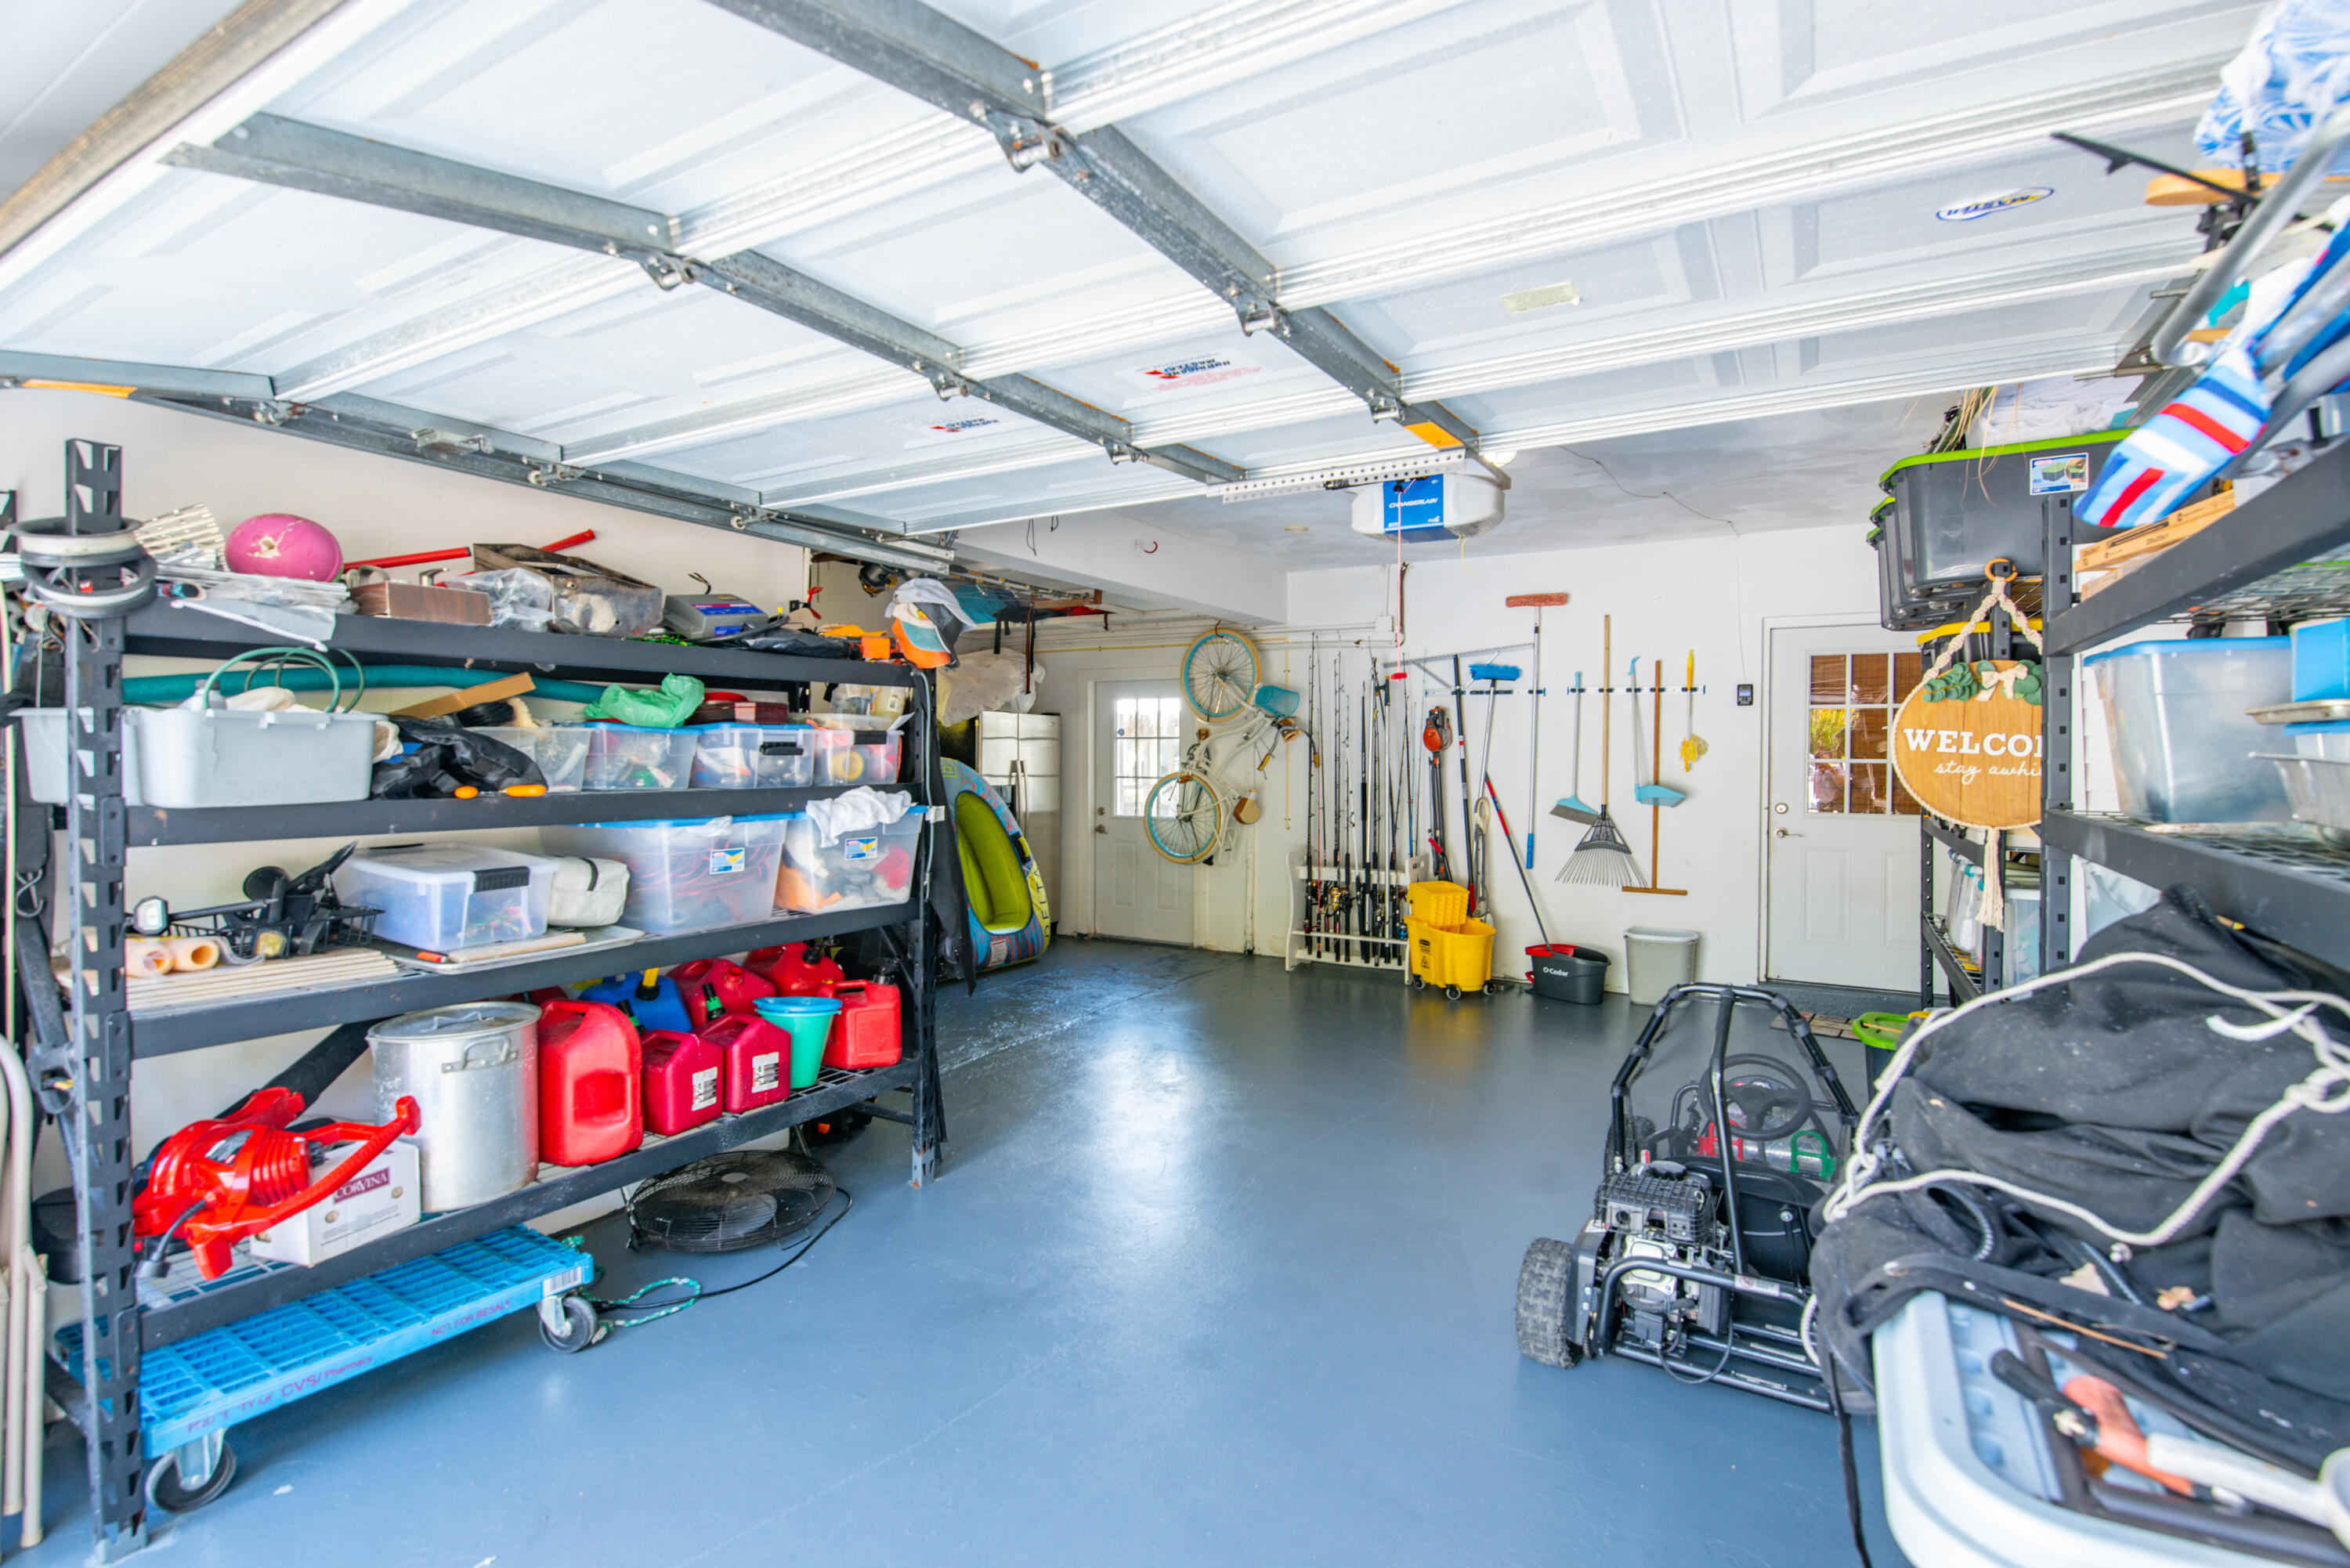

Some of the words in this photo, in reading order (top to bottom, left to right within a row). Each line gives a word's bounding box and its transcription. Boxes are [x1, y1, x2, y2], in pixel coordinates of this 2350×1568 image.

[1903, 728, 2042, 757] WELCO
[1934, 760, 1983, 785] stay
[1989, 761, 2042, 776] awhi
[334, 1172, 389, 1199] CORVINA
[432, 1324, 451, 1336] NOT
[454, 1314, 474, 1328] FOR
[324, 1356, 373, 1379] Pharmacy
